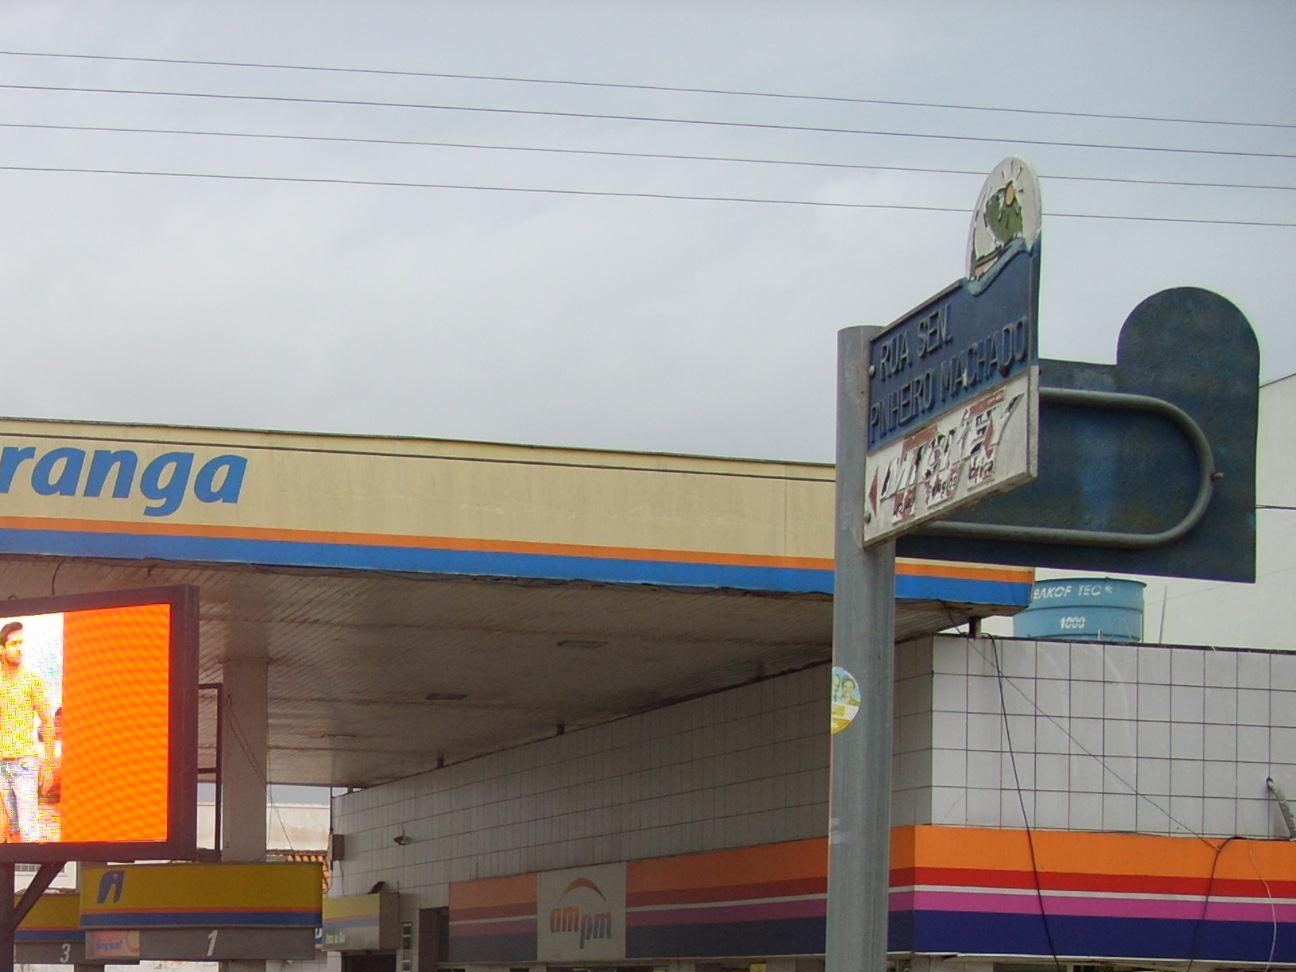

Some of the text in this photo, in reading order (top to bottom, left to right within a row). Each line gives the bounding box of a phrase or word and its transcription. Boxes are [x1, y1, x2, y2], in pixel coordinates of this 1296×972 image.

[880, 303, 953, 382] RUA SEN.
[871, 316, 1028, 444] PINHEIRO MACHADO
[1060, 616, 1086, 629] 1000
[59, 943, 71, 963] 3
[206, 929, 219, 957] 1
